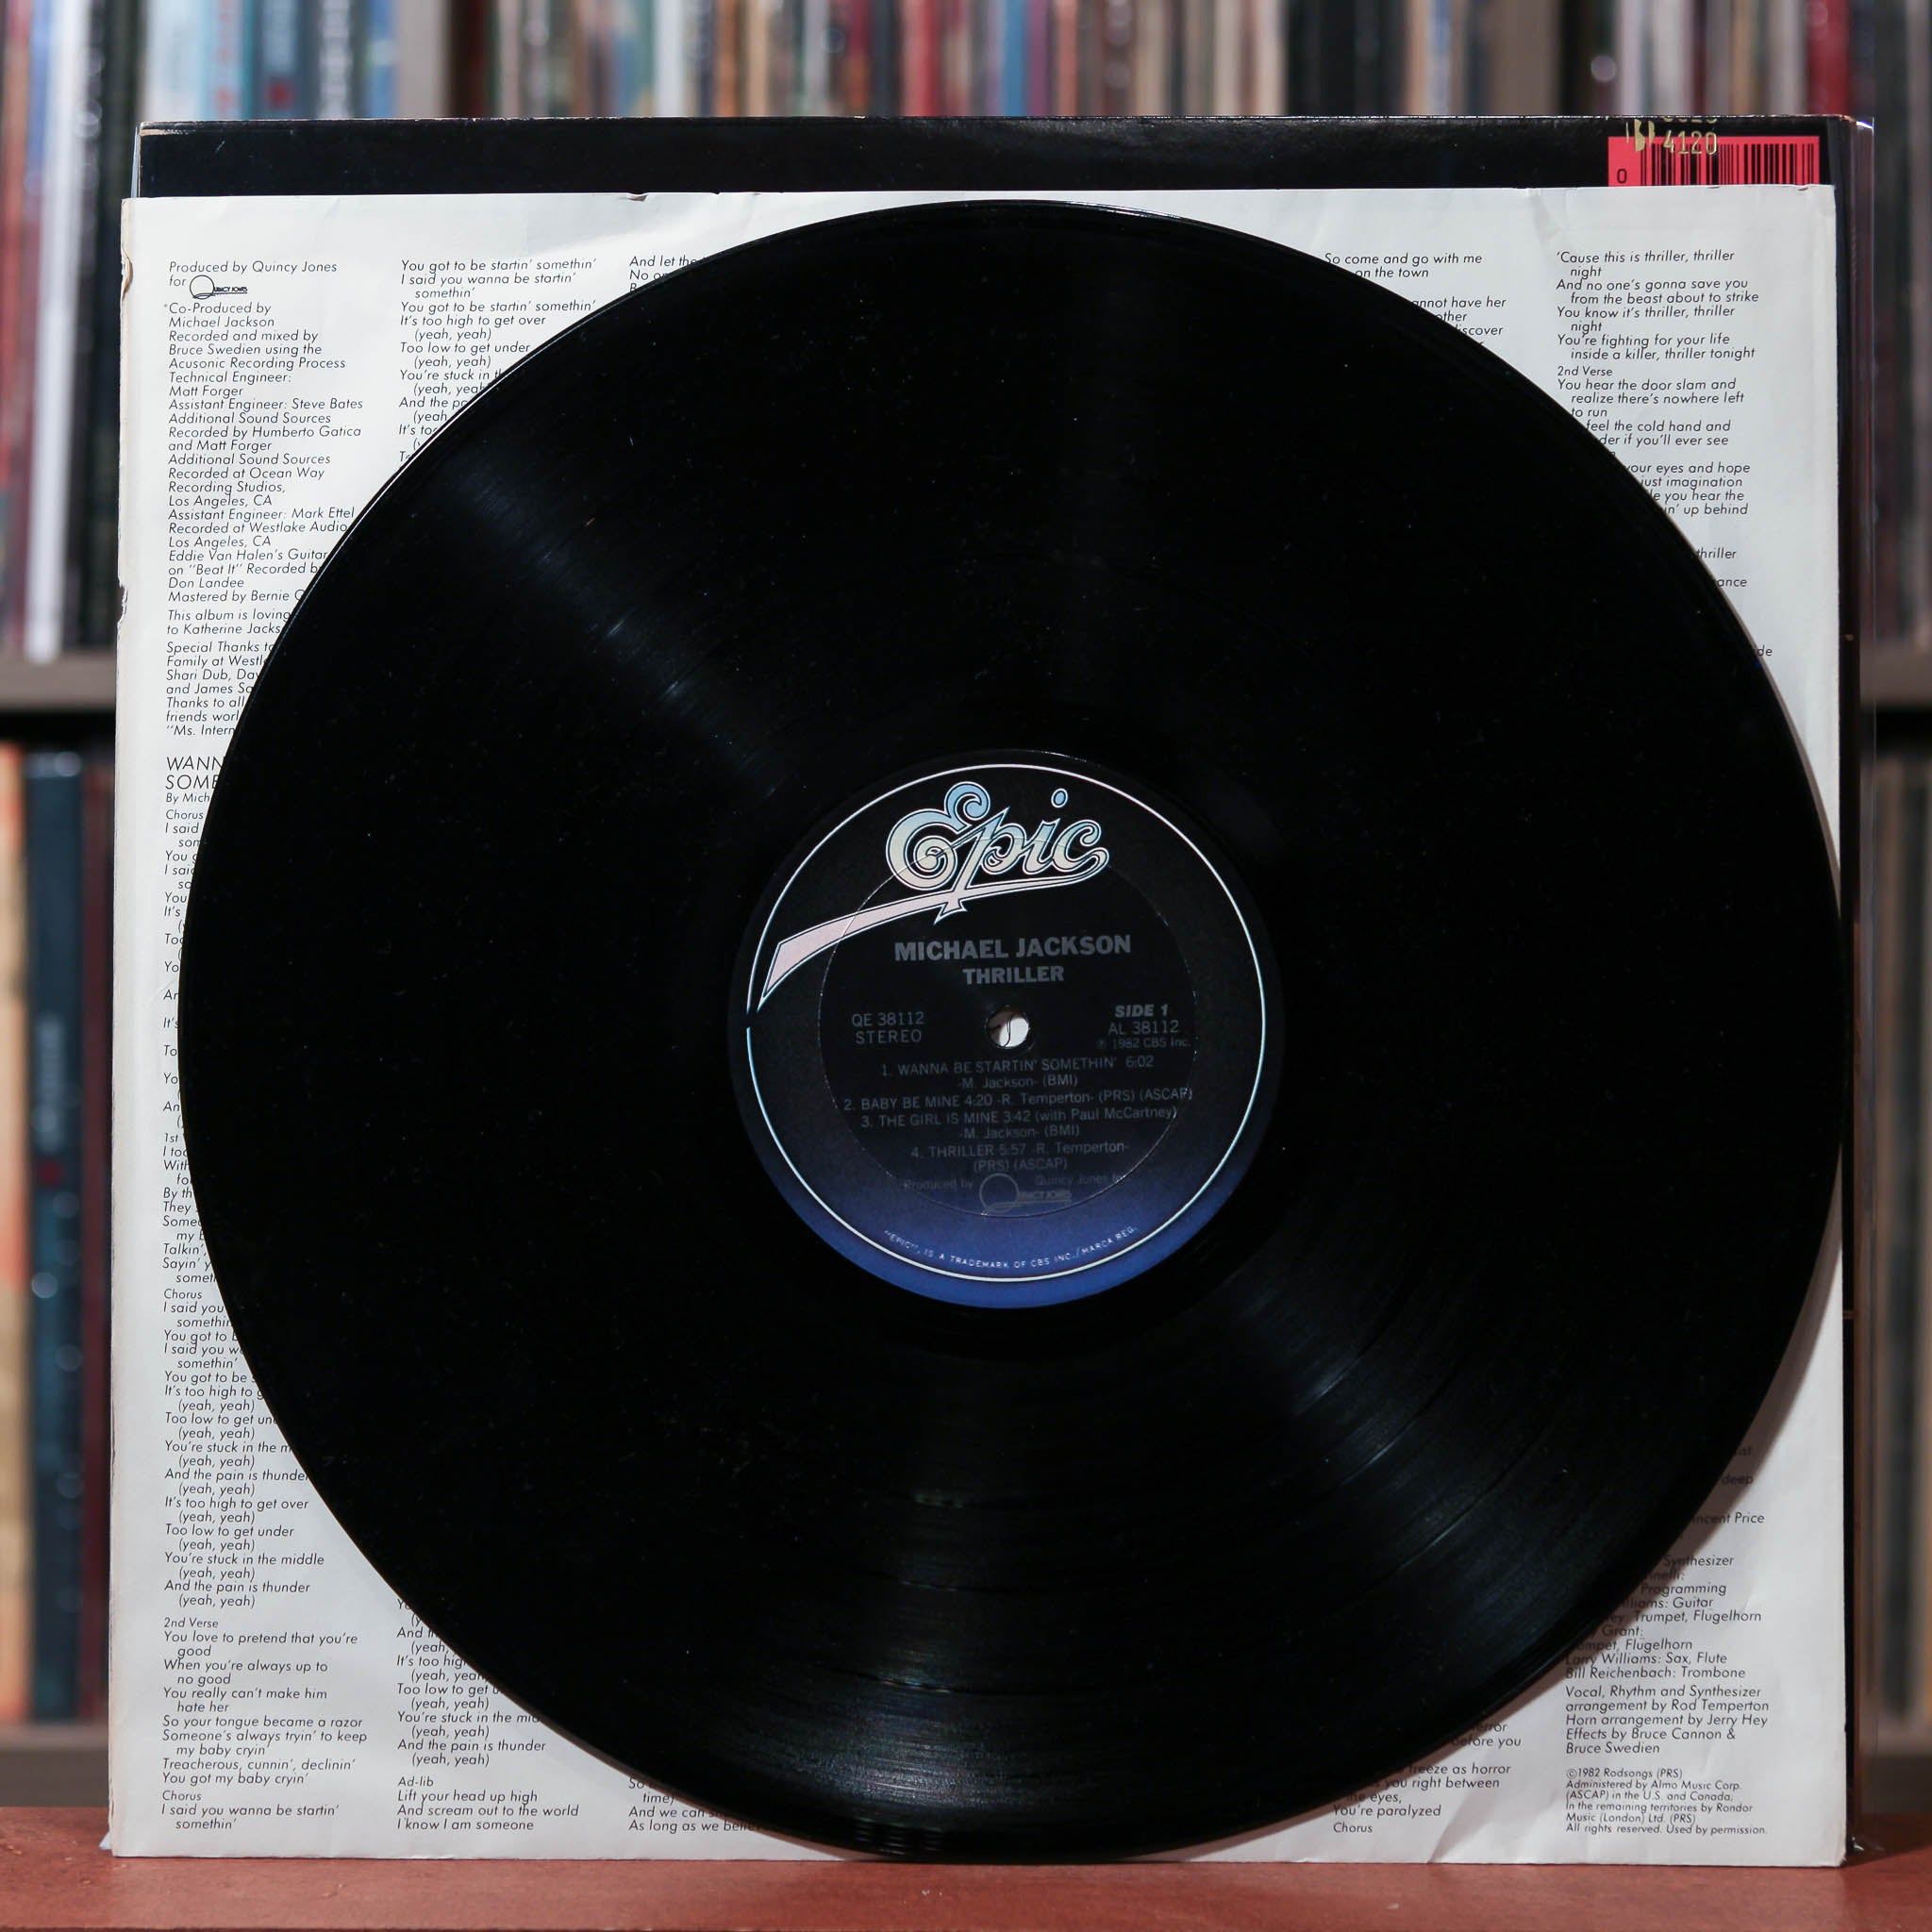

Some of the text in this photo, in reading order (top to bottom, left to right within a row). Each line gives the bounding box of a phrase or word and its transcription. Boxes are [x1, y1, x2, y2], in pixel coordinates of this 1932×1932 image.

[1662, 130, 1718, 155] 4120
[1616, 168, 1627, 184] 0
[1325, 253, 1340, 264] So
[1383, 252, 1408, 264] and
[1412, 256, 1429, 267] go
[1433, 252, 1459, 264] with
[1557, 250, 1734, 263] 'Cause this is thriller, thriller
[170, 260, 337, 275] Produced by Quincy Jones
[402, 258, 596, 274] You got to be startin' somethin'
[1571, 265, 1602, 280] night
[170, 275, 186, 286] for
[1556, 278, 1748, 293] And no one's gonna save you
[1571, 291, 1759, 304] from the beast about to strike
[256, 302, 271, 316] by
[169, 315, 274, 327] Michael Jackson
[169, 329, 318, 344] Recorded and mixed by
[169, 356, 345, 372] Acusonic Recording Process
[1557, 365, 1613, 376] 2nd Verse
[170, 370, 292, 385] Technical Engineer:
[169, 385, 243, 399] Matt Forger
[169, 548, 328, 561] Eddie Van Halen's Guitar
[169, 576, 244, 588] Don Landee
[886, 781, 1109, 924] Epic
[894, 934, 1132, 963] MICHAEL JACKSON
[963, 966, 1065, 986] THRILLER
[1115, 1003, 1169, 1019] SIDE 1
[852, 1011, 924, 1029] QE 38112
[1108, 1019, 1179, 1036] AL 38112
[854, 1029, 922, 1046] STEREO
[1113, 1039, 1140, 1050] 1982
[1143, 1037, 1167, 1049] CBS
[882, 1055, 1155, 1077] 1. WANNA BE STARTIN' SOMETHIN' 6:02
[1042, 1074, 1077, 1088] (BMI)
[844, 1098, 857, 1112] 2.
[861, 1097, 897, 1111] BABY
[903, 1096, 921, 1109] BE
[925, 1095, 960, 1109] MINE
[964, 1094, 993, 1107] 4:20
[1099, 1089, 1134, 1104] (PRS)
[860, 1115, 874, 1129] 3.
[878, 1114, 906, 1127] THE
[909, 1112, 941, 1126] GIRL
[947, 1112, 959, 1125] IS
[963, 1111, 999, 1125] MINE
[1035, 1109, 1065, 1123] (with
[1071, 1108, 1099, 1121] Paul
[1104, 1105, 1177, 1121] McCartney)
[1044, 1124, 1080, 1139] (BMI)
[910, 1146, 924, 1159] 4.
[928, 1144, 995, 1158] THRILLER
[973, 1158, 1067, 1173] (PRS) (ASCAP)
[924, 1249, 933, 1257] IS
[950, 1255, 1008, 1268] TRADEMARK
[1014, 1260, 1026, 1268] OF
[1030, 1257, 1049, 1267] CBS
[1115, 1226, 1138, 1240] REG.
[164, 1617, 218, 1628] 2nd Verse
[164, 1631, 358, 1647] You love to pretend that you're
[1566, 1685, 1760, 1700] Vocal, Rhythm and Synthesizer
[1566, 1727, 1735, 1743] Effects by Bruce Cannon &
[398, 1776, 433, 1787] Ad-lib
[1604, 1768, 1653, 1780] Rodsongs
[1655, 1768, 1682, 1780] (PRS)
[162, 1790, 202, 1801] Chorus
[398, 1790, 537, 1805] Lift your head up high
[1566, 1822, 1768, 1836] All rights reserved. Used by permission.
